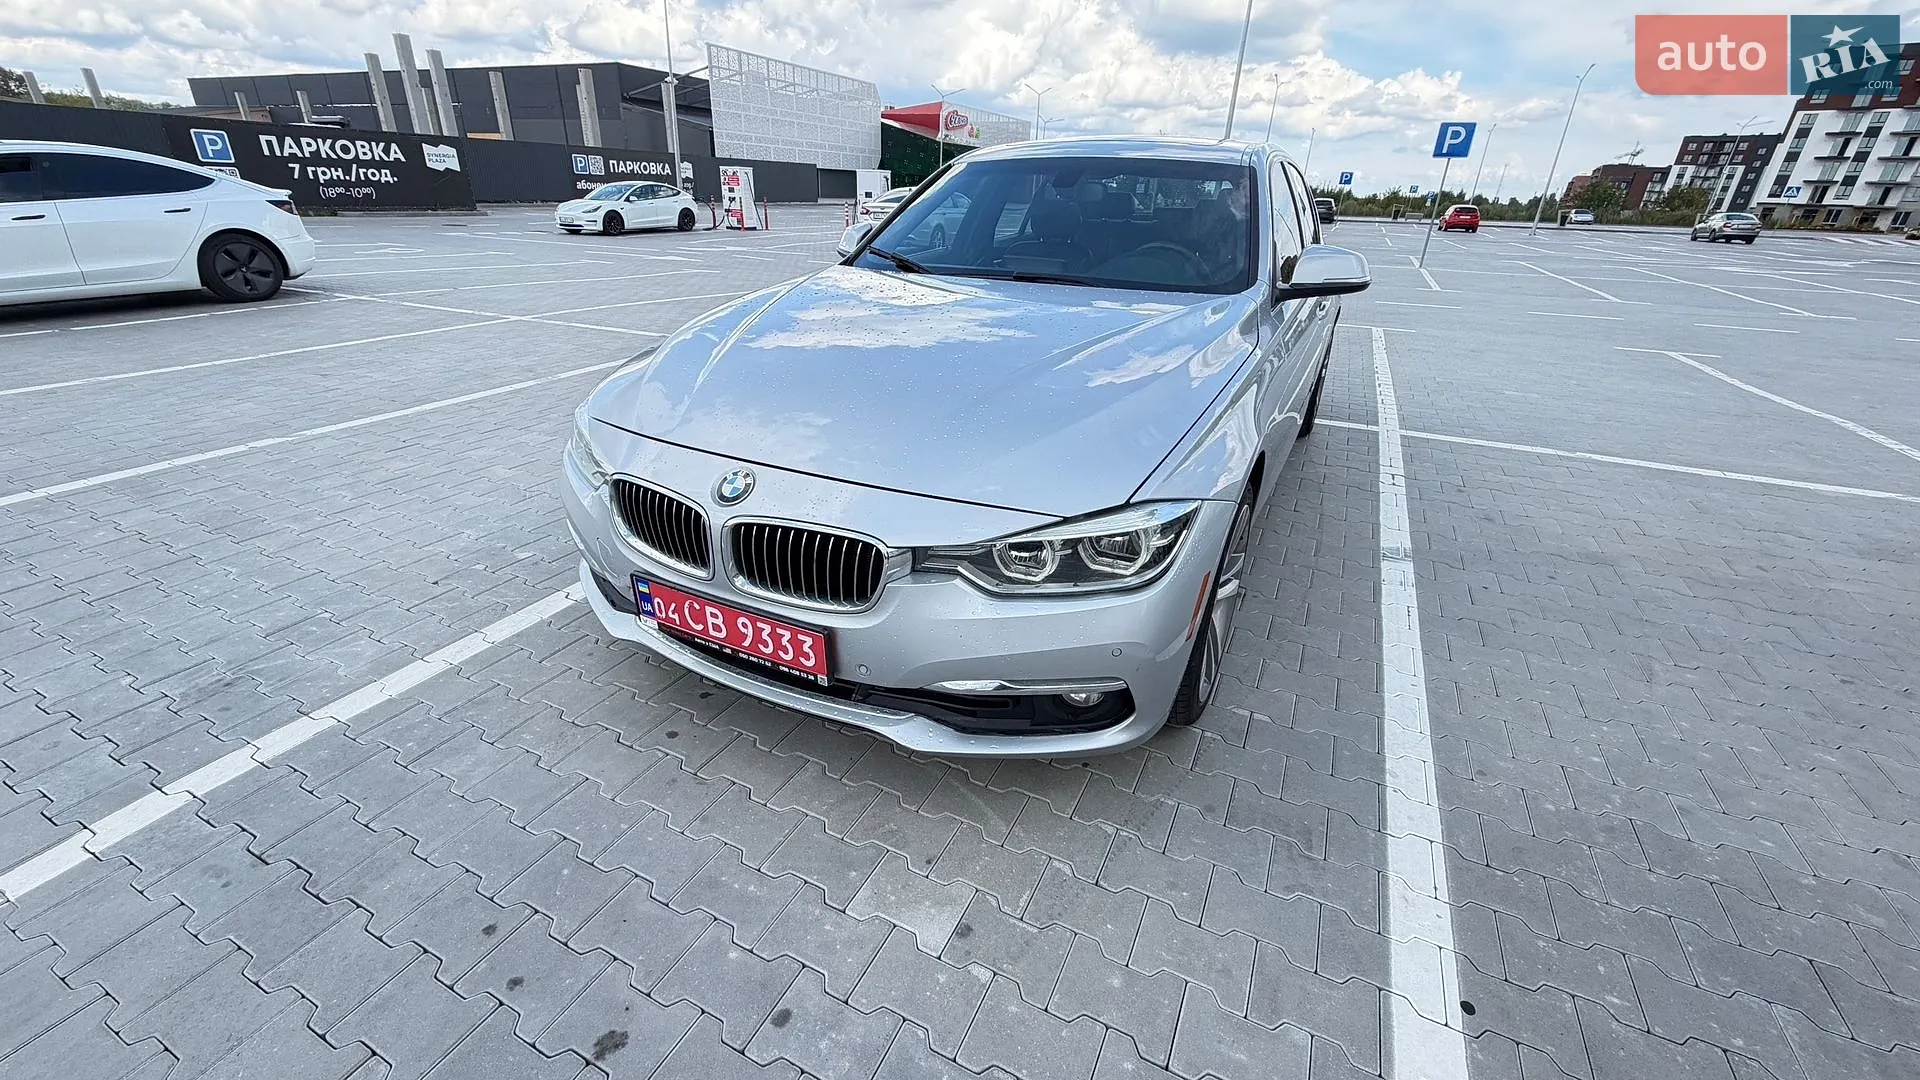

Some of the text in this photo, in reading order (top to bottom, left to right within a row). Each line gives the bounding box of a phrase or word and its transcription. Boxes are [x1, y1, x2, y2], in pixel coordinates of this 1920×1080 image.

[202, 134, 222, 158] P
[258, 134, 407, 163] ПАРКОВКА
[1442, 126, 1467, 154] P
[288, 163, 398, 184] 7 грн./год.
[577, 157, 585, 171] P
[609, 160, 672, 175] ПАРКОВКА
[1341, 173, 1351, 184] P
[641, 600, 654, 613] UA
[736, 616, 816, 667] 9333
